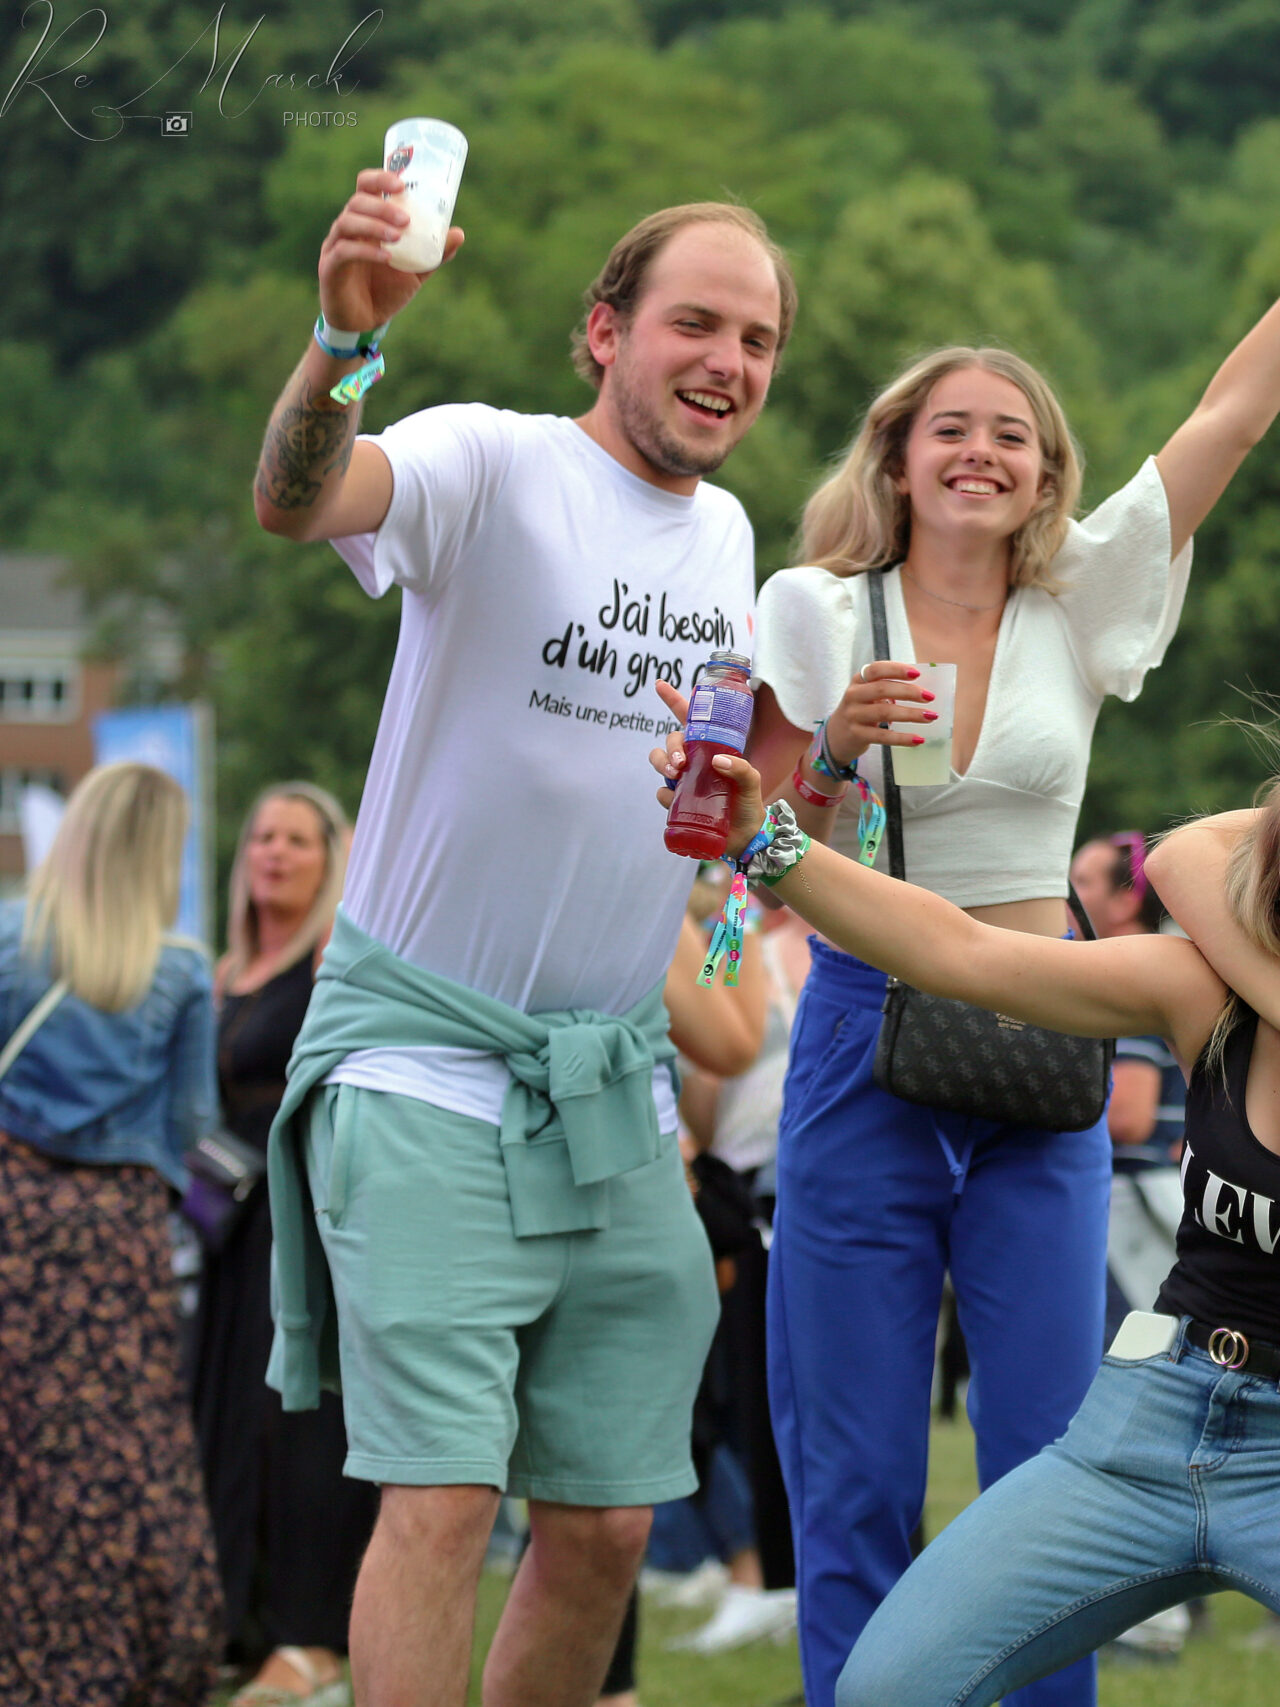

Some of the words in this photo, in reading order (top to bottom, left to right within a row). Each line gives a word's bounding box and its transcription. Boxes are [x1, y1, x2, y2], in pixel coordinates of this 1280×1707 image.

[599, 578, 651, 636] J'ai
[659, 591, 735, 648] besoin
[542, 621, 617, 679] d'un
[623, 651, 683, 697] gros
[528, 689, 573, 717] Mais
[576, 704, 608, 725] une
[608, 711, 654, 733] petite
